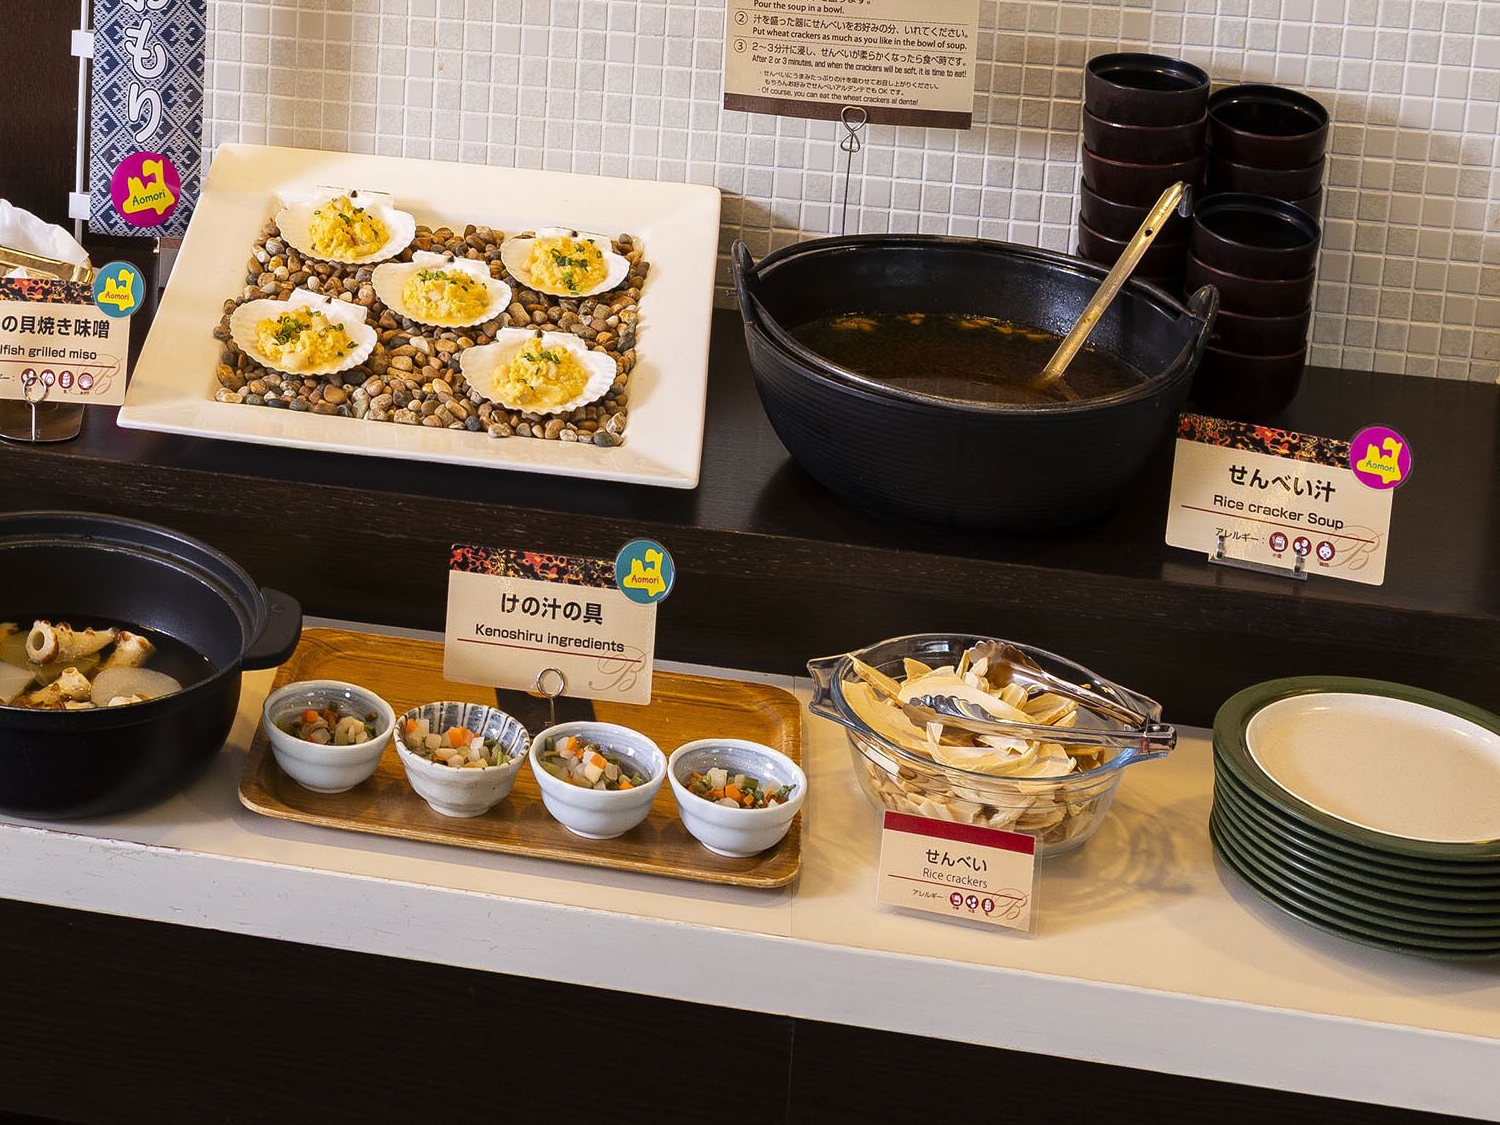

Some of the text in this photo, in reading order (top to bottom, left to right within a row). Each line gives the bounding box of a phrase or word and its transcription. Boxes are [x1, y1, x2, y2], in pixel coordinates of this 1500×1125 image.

[754, 0, 772, 8] Pour
[774, 1, 786, 10] the
[788, 3, 806, 12] soup
[823, 5, 844, 14] bowl.
[752, 27, 765, 35] Put
[767, 29, 789, 37] wheat
[791, 31, 821, 40] crackers
[832, 34, 852, 42] much
[854, 35, 862, 43] as
[863, 36, 877, 44] you
[880, 37, 892, 45] like
[894, 37, 901, 45] in
[903, 38, 915, 47] the
[917, 39, 935, 48] bowl
[946, 41, 967, 51] soup.
[782, 57, 787, 65] 3
[788, 58, 813, 67] minutes,
[814, 60, 825, 68] and
[844, 62, 854, 70] the
[855, 64, 882, 72] crackers
[883, 65, 893, 73] will
[894, 65, 902, 73] be
[919, 67, 923, 75] it
[931, 68, 945, 76] time
[947, 69, 954, 77] to
[954, 70, 967, 78] eat!
[770, 88, 792, 96] course,
[842, 93, 862, 102] wheat
[863, 96, 889, 104] crackers
[131, 188, 167, 207] Aomori
[104, 292, 130, 301] Aomori
[28, 346, 66, 359] grilled
[69, 349, 97, 360] miso
[1365, 459, 1395, 474] Aomori
[1228, 464, 1336, 503] せんべい汁
[1213, 494, 1345, 531] Rice cracker Soup
[631, 574, 660, 584] Aomori
[501, 593, 603, 625] けの汁の具
[475, 623, 625, 653] Kenoshiru ingredients
[925, 849, 988, 872] せんべい
[922, 867, 988, 889] Rice crackers
